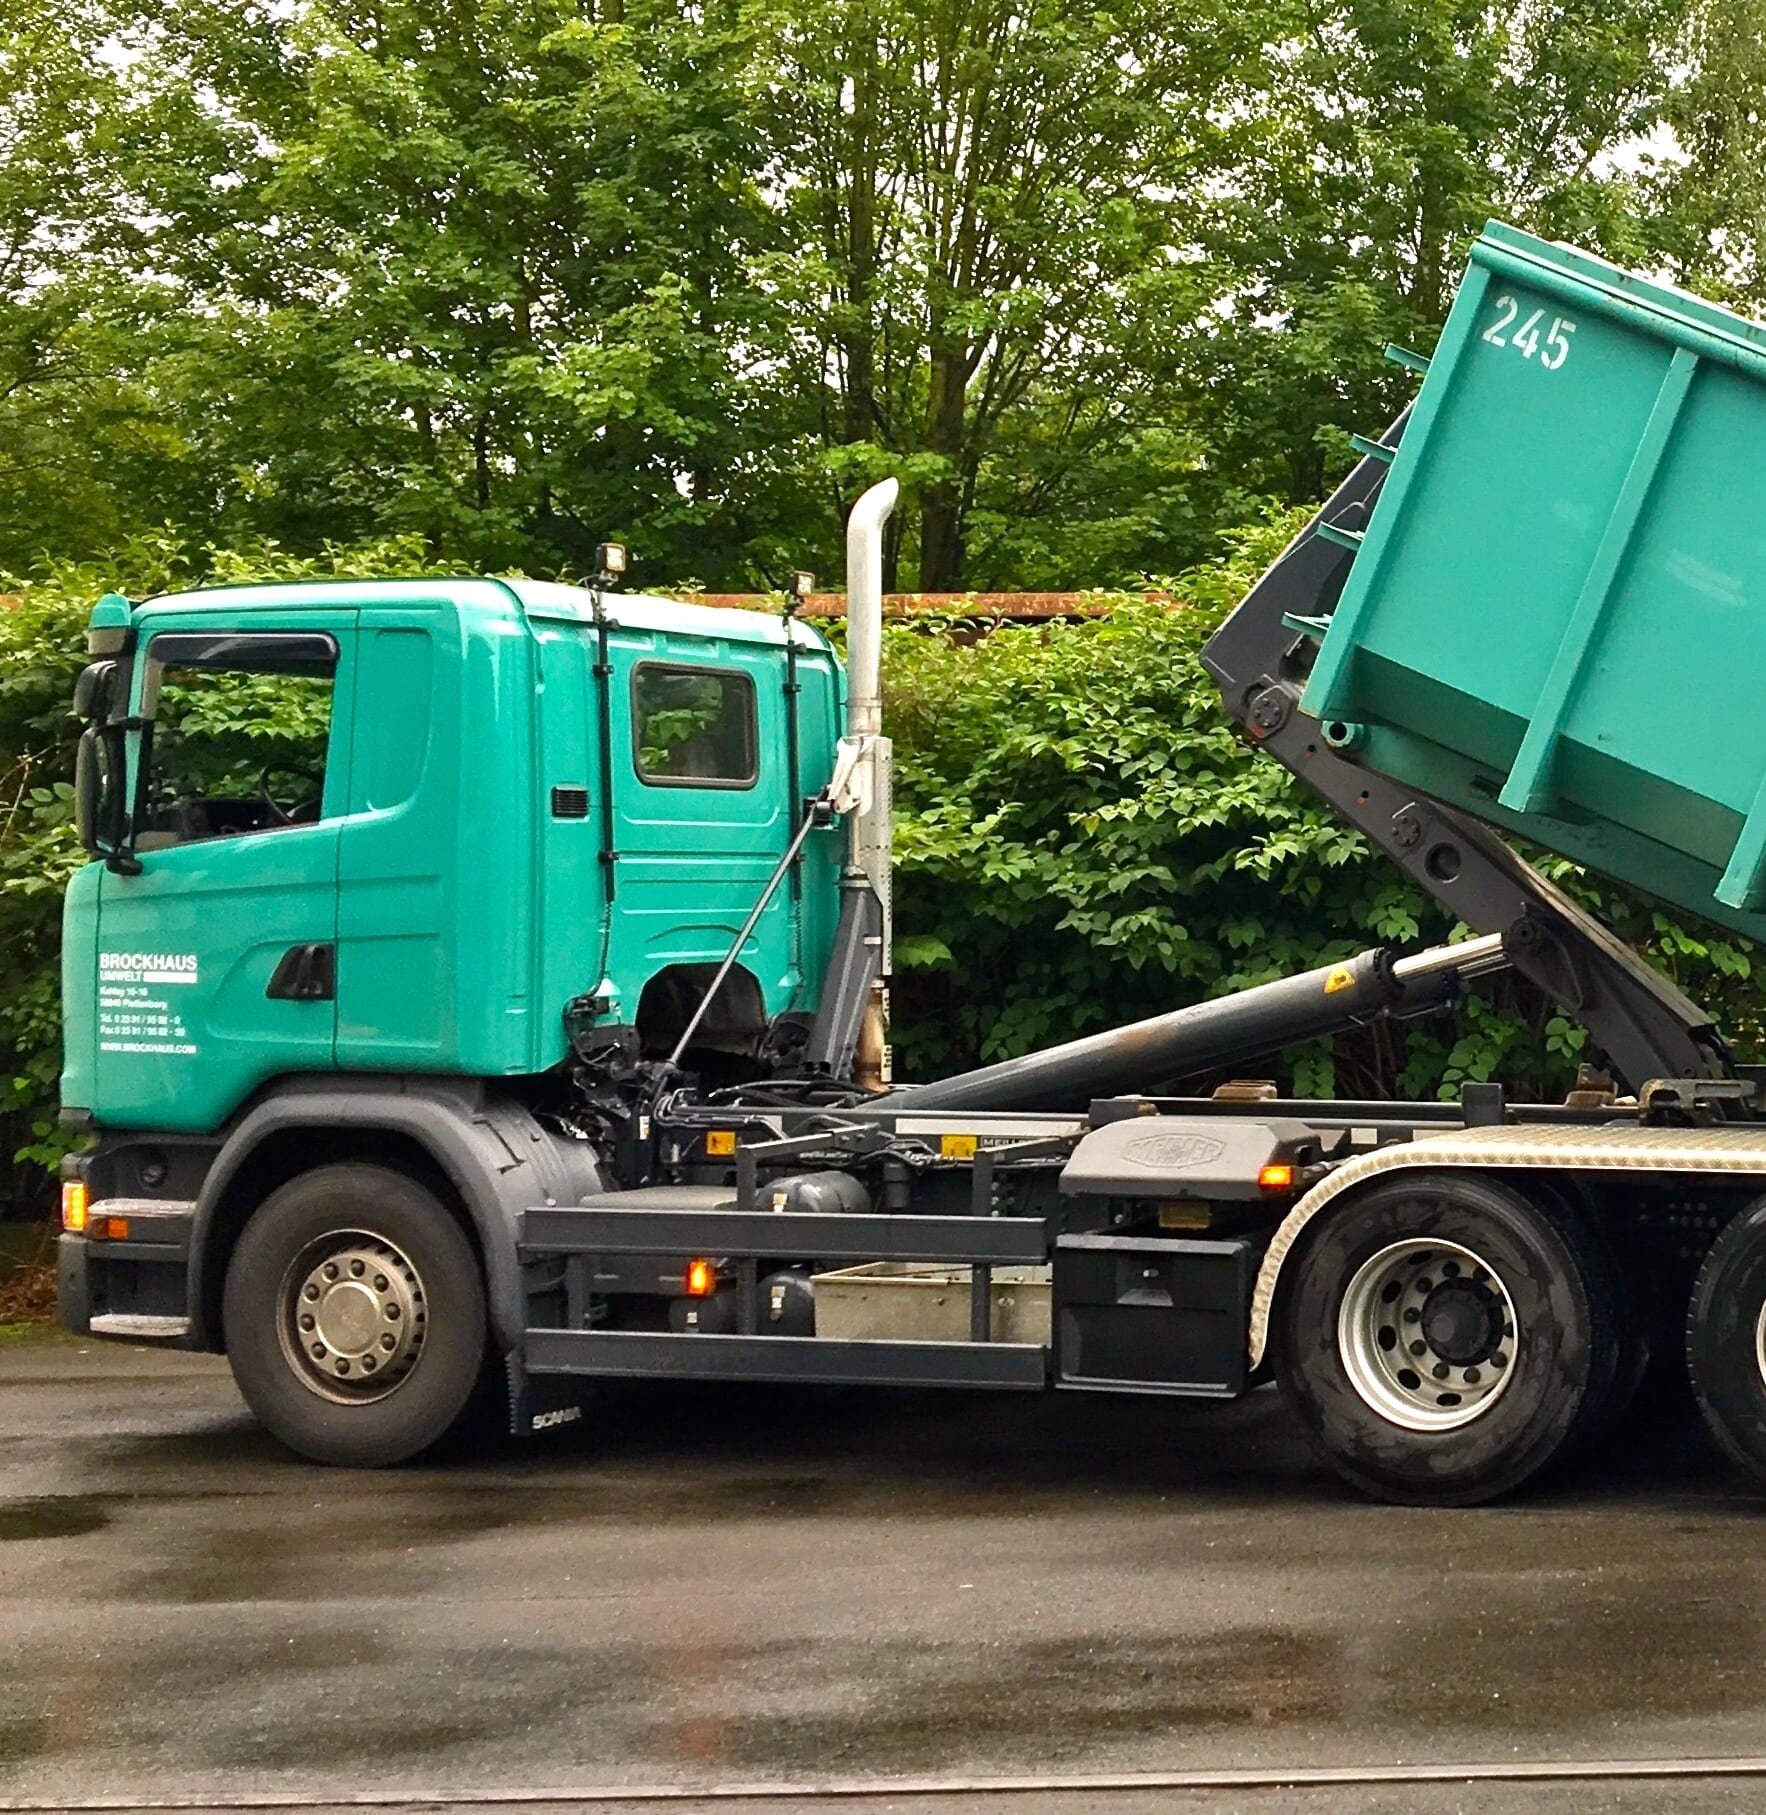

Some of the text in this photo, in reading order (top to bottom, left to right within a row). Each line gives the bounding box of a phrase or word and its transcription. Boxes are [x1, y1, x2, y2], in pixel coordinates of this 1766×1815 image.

[1482, 296, 1576, 371] 245
[100, 953, 198, 971] BROCKHAUS
[100, 970, 142, 982] UMWELT
[532, 1405, 582, 1429] SCANIA
